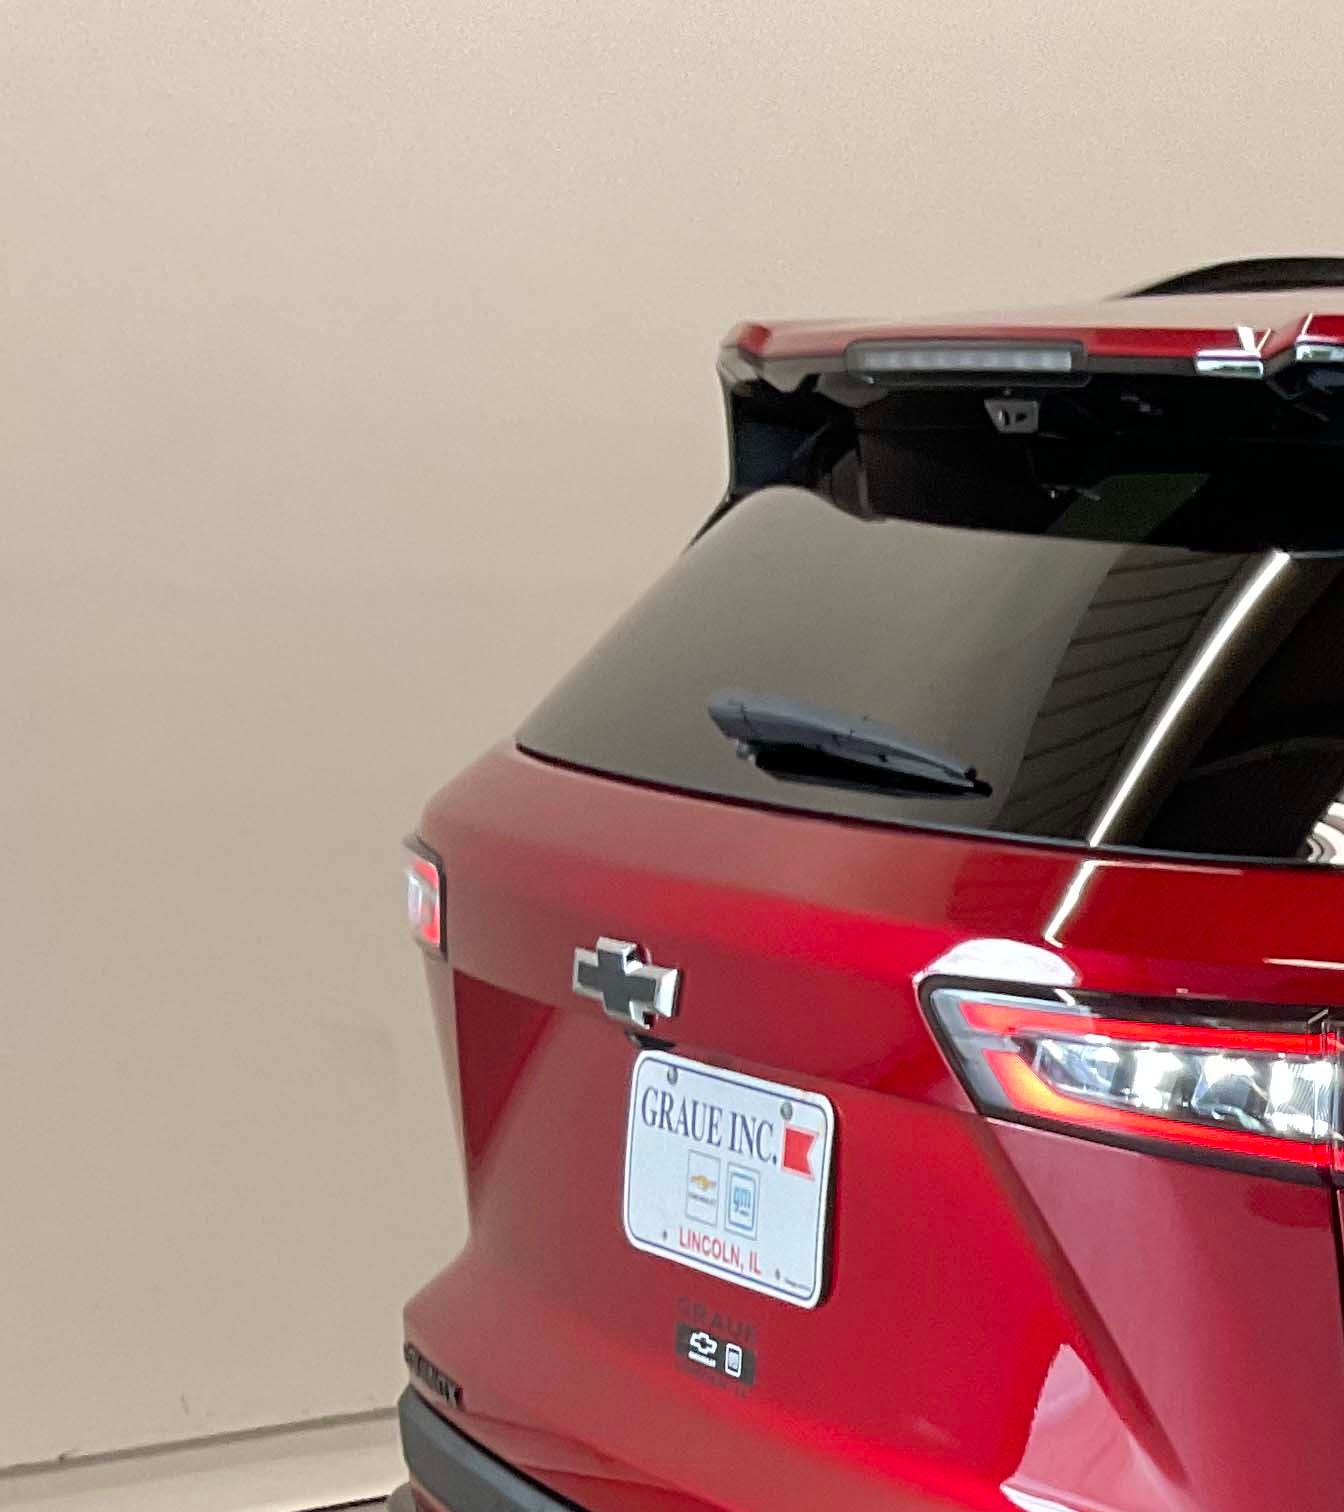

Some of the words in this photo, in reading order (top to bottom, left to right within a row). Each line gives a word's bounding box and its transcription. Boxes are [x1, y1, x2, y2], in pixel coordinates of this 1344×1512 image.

[641, 1086, 723, 1148] GRAUE
[729, 1111, 778, 1166] INC.
[679, 1226, 744, 1273] LINCOLN,
[749, 1252, 762, 1276] IL
